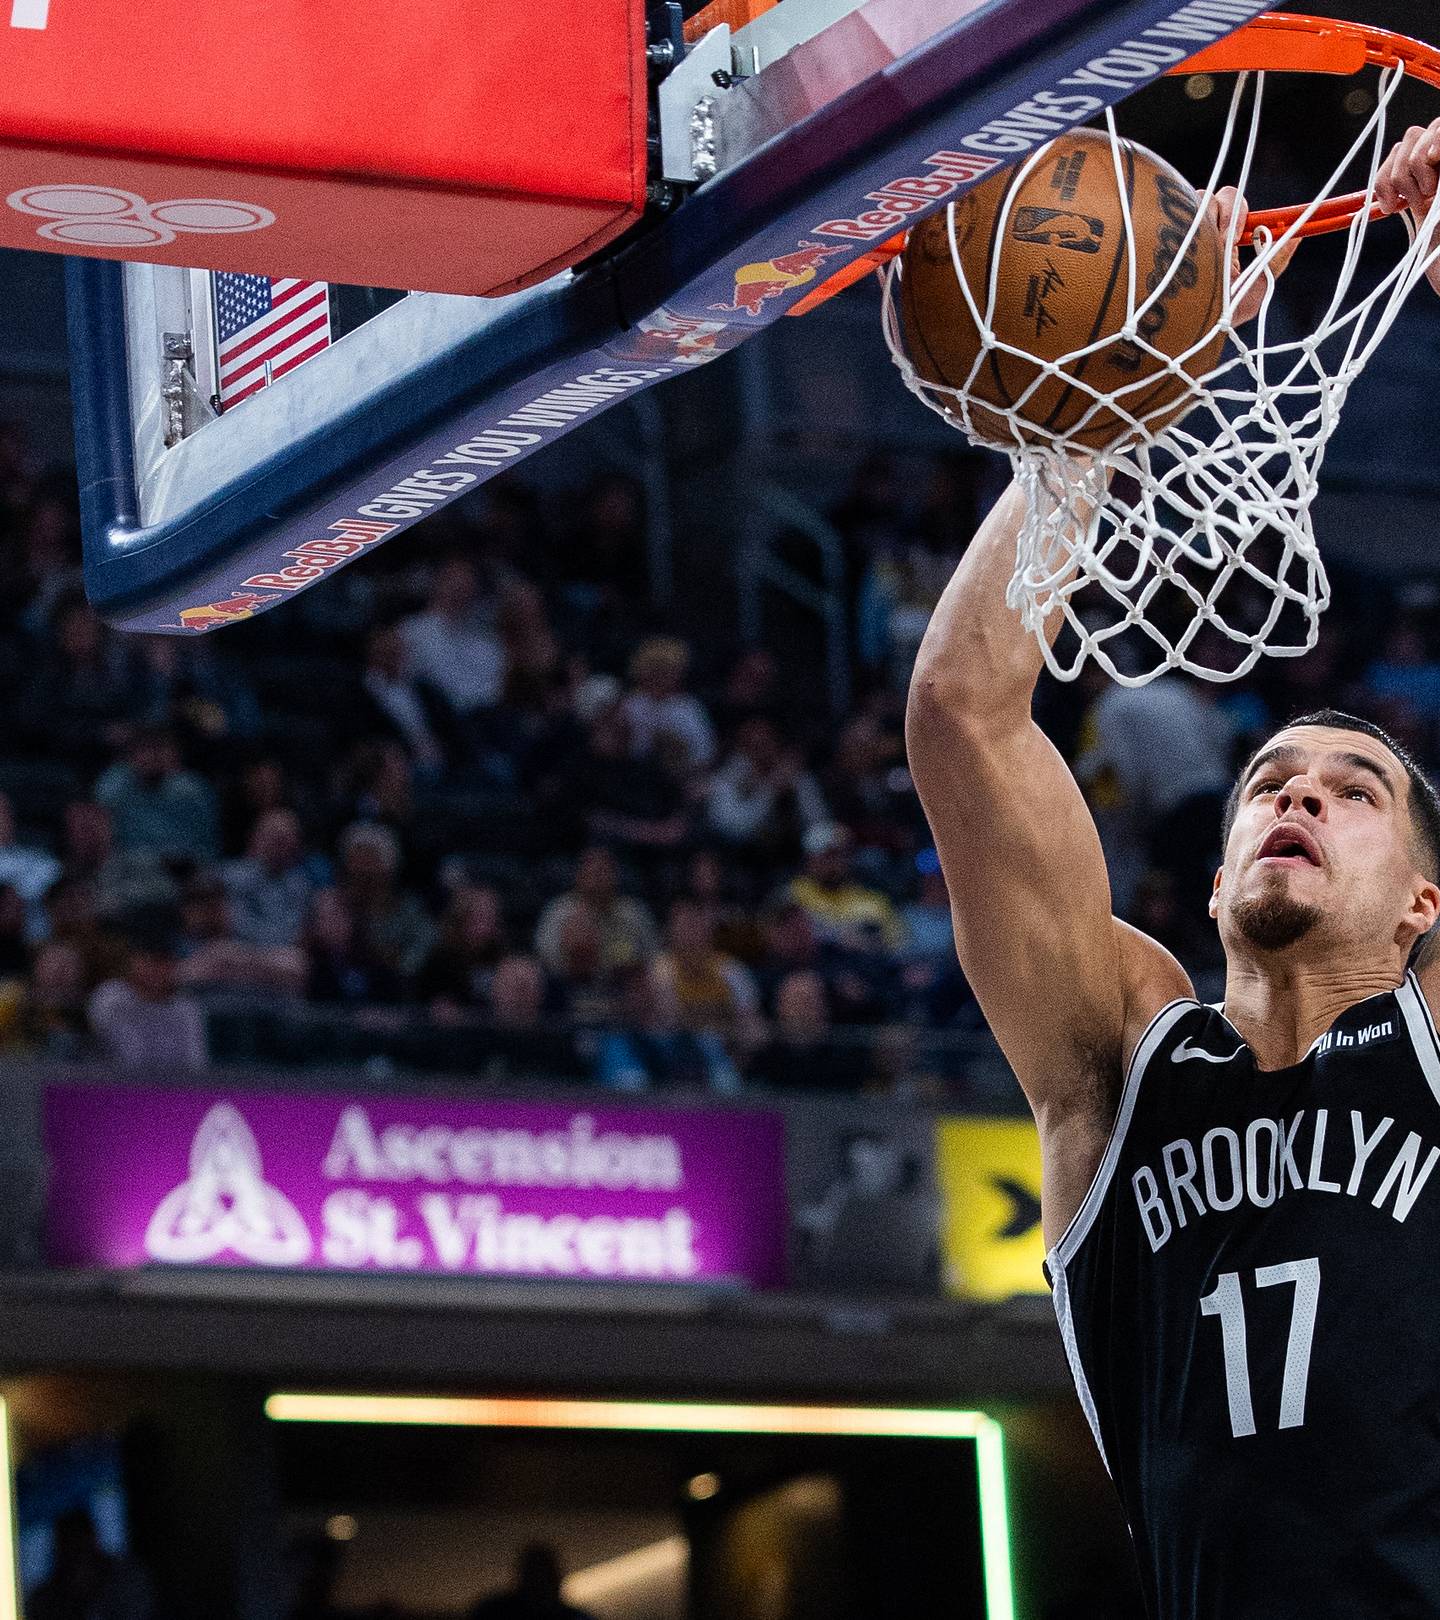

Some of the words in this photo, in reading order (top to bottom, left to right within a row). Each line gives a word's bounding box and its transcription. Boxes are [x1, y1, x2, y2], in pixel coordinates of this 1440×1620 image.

[960, 91, 1102, 153] GIVES
[1059, 41, 1187, 89] YOU
[357, 469, 478, 519] GIVES
[437, 428, 543, 466] YOU
[498, 367, 673, 427] WINGS.
[1336, 1030, 1354, 1047] In
[1357, 1021, 1393, 1045] Won
[323, 1104, 684, 1192] Ascension
[322, 1189, 423, 1268] St.
[418, 1193, 699, 1278] Vincent
[1199, 1257, 1321, 1438] 17
